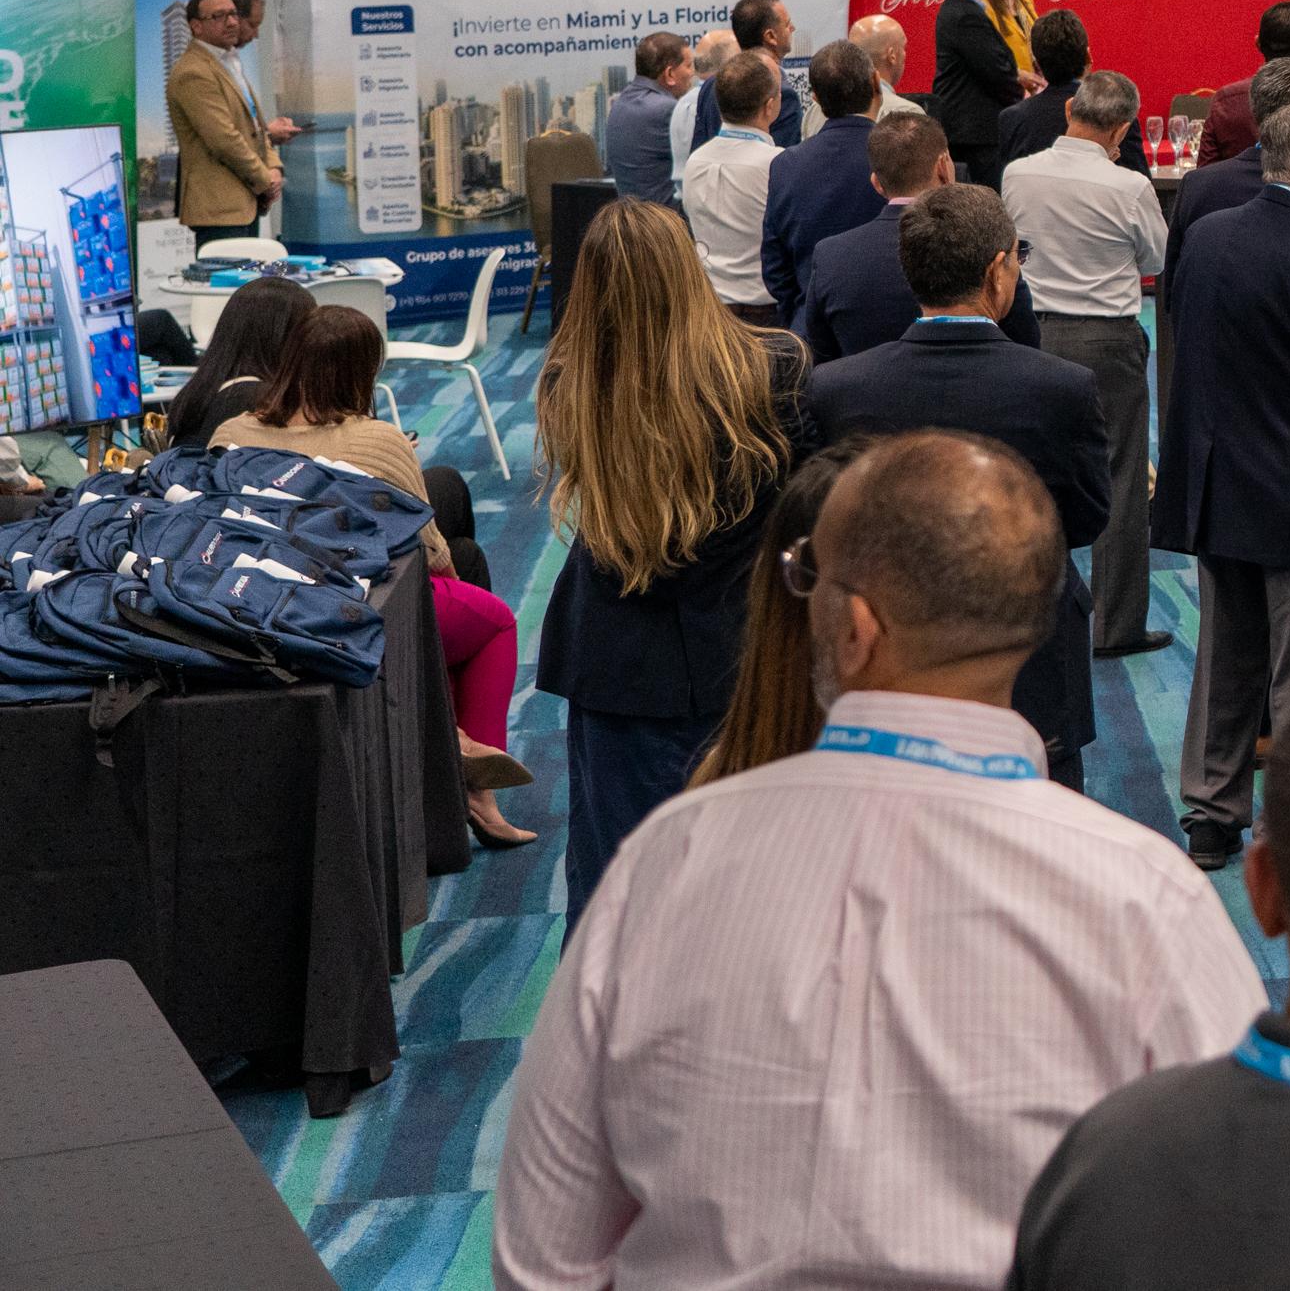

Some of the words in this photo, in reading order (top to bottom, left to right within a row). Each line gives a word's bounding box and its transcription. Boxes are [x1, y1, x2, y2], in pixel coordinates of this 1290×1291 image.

[360, 11, 405, 21] Nuestros
[536, 15, 561, 31] en
[566, 8, 627, 29] Miami
[631, 10, 643, 30] y
[648, 7, 670, 26] La
[360, 22, 405, 32] Servicios
[454, 44, 489, 58] con
[493, 32, 641, 56] acompañamient
[405, 250, 447, 265] Grupo
[448, 247, 466, 260] de
